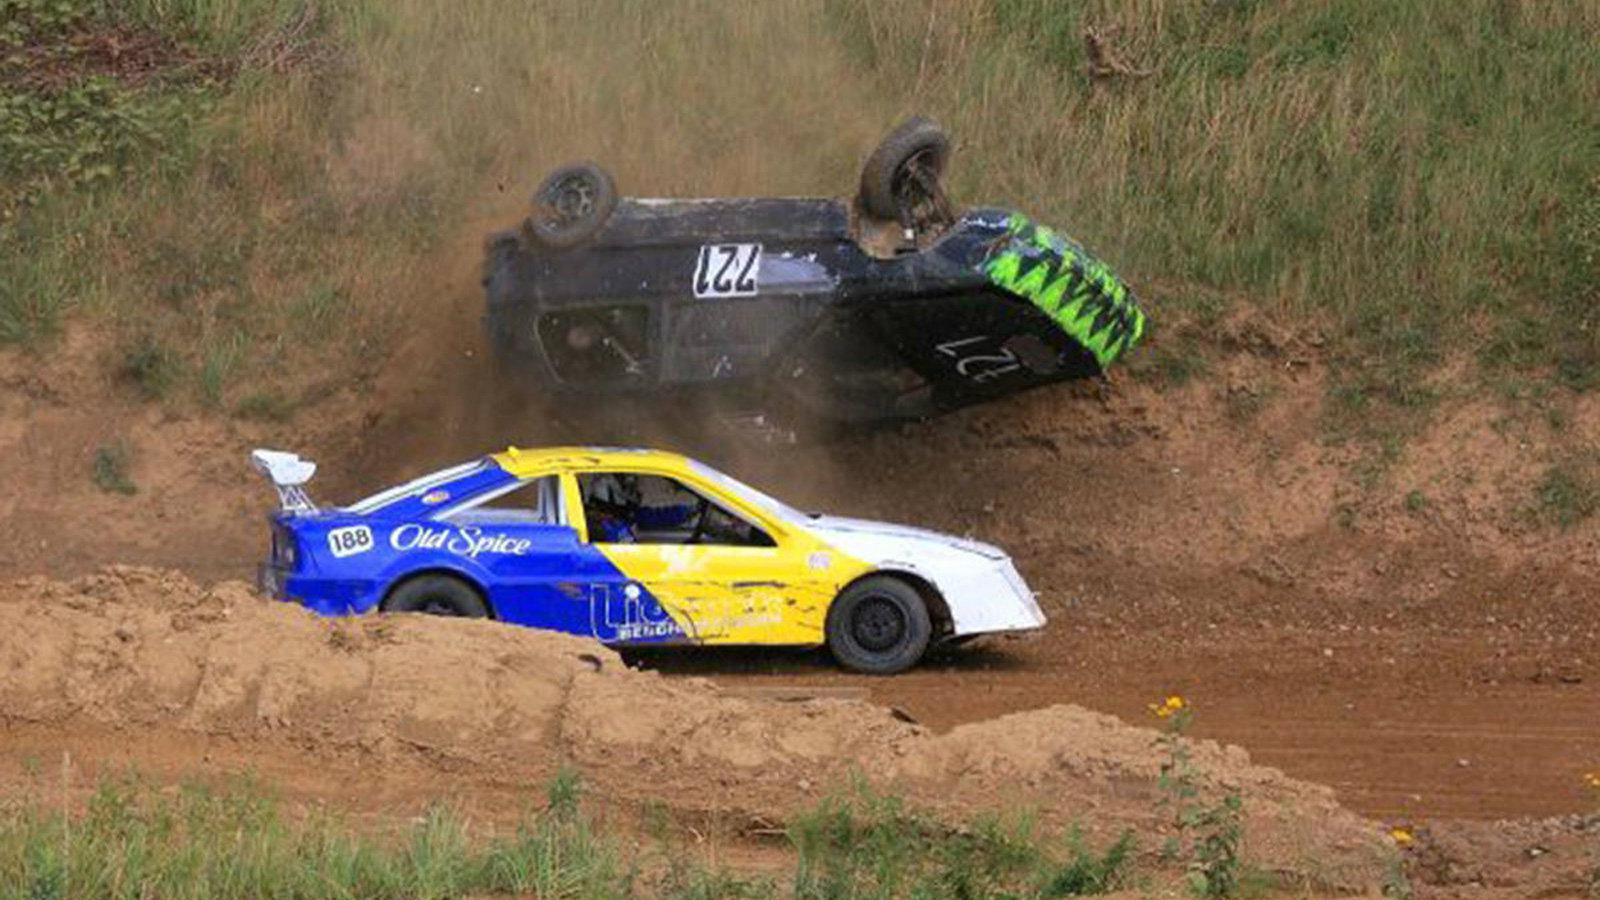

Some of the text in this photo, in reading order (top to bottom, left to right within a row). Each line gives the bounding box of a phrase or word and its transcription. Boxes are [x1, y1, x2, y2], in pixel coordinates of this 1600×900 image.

[695, 245, 760, 295] 721
[332, 528, 370, 552] 188
[389, 523, 532, 558] Old Spice
